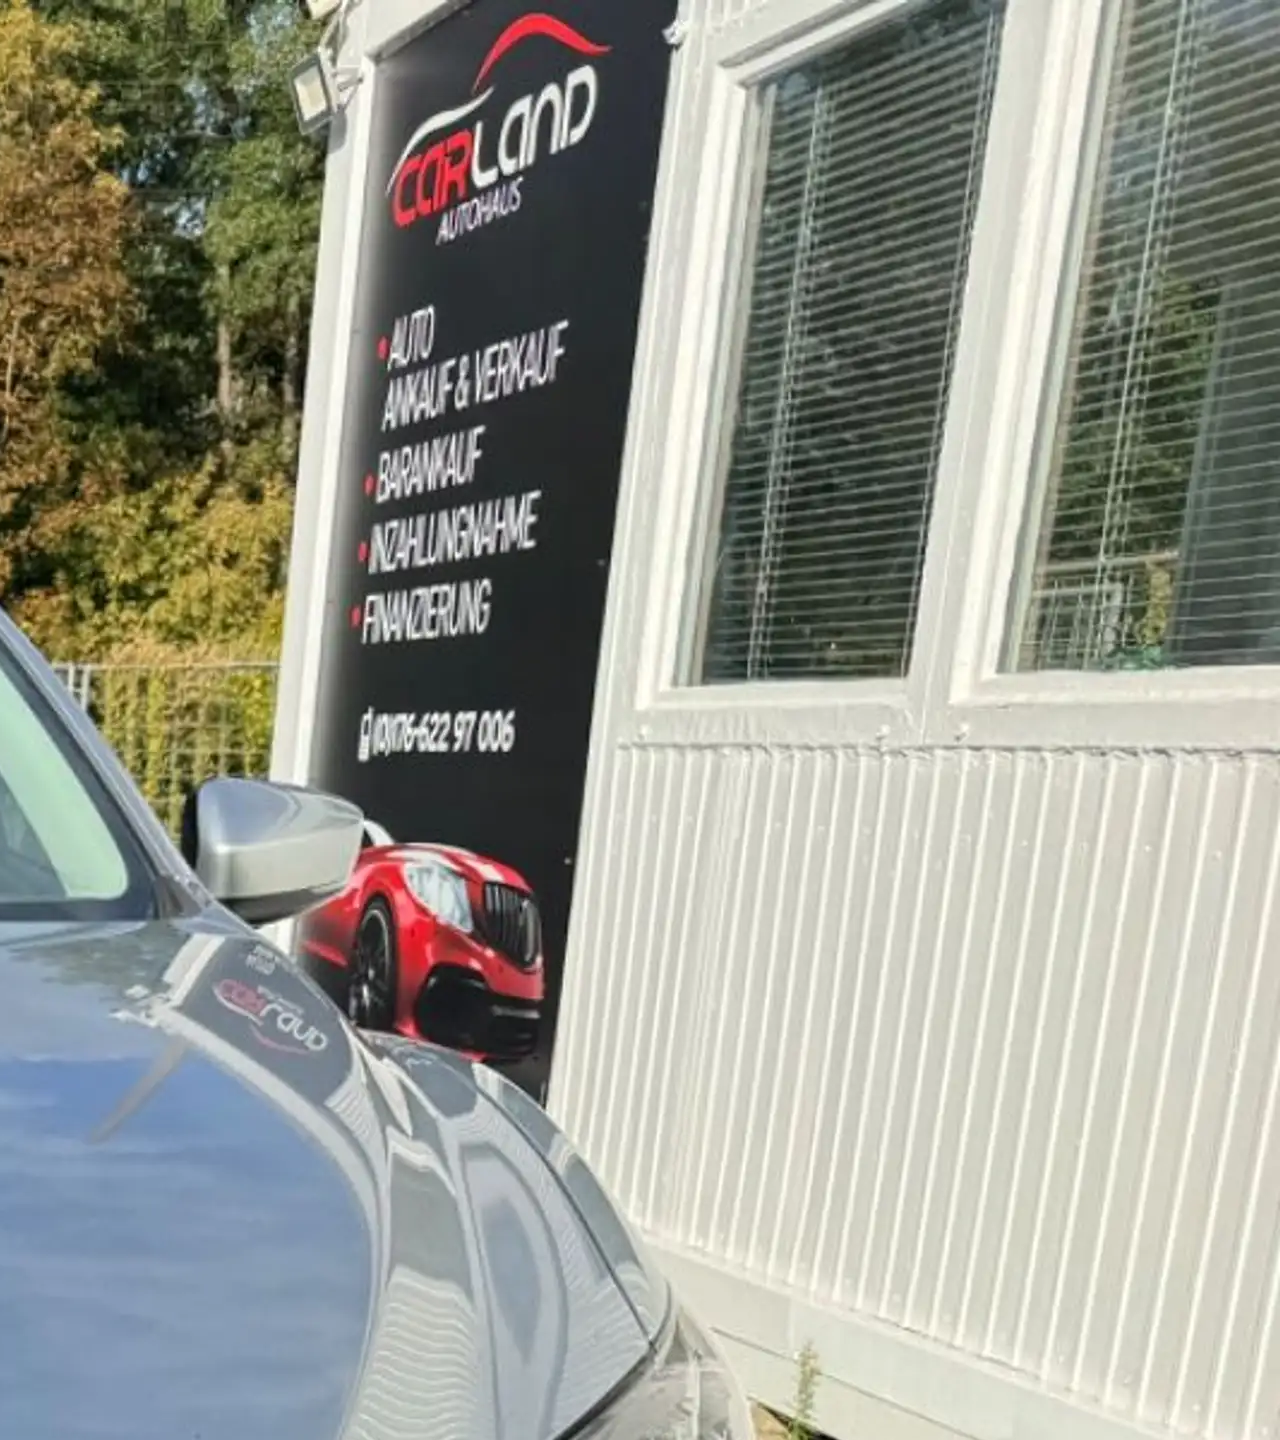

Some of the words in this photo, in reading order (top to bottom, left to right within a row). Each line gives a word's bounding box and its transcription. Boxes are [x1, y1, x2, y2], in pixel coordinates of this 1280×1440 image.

[435, 177, 524, 246] AUTOHAUS
[387, 304, 436, 372] AUTO
[380, 357, 456, 433] ANKAUF
[454, 354, 471, 411] &
[474, 318, 570, 405] VERKAUF
[375, 424, 487, 504] BARANKAUF
[367, 489, 542, 575] INZAHLUNGNAHME
[361, 577, 492, 645] FINANZIERUNG
[452, 709, 478, 753] 97
[477, 708, 516, 753] 006
